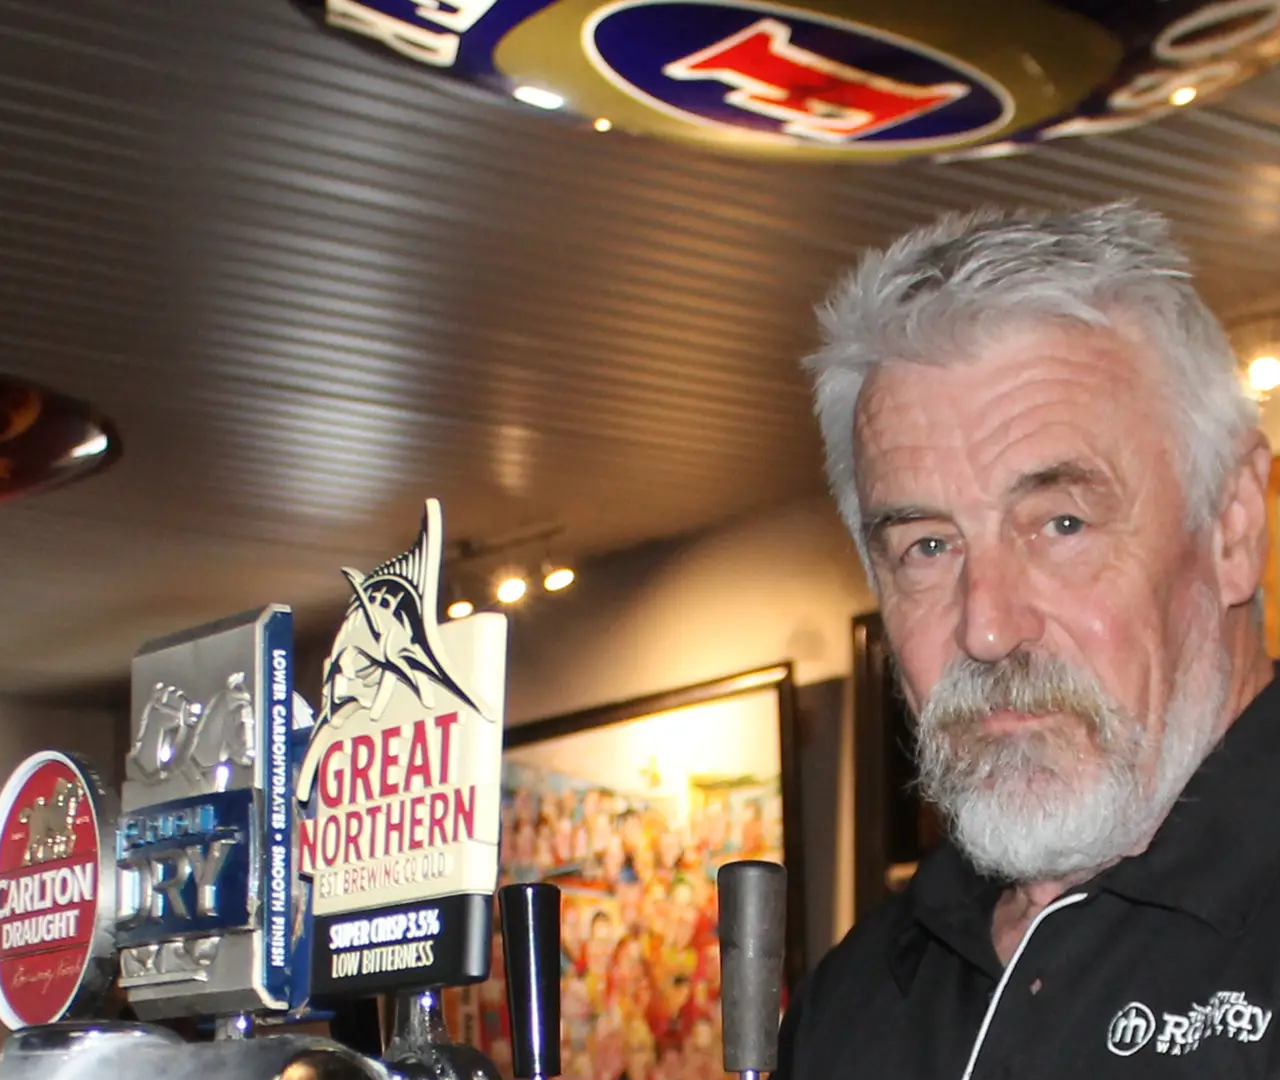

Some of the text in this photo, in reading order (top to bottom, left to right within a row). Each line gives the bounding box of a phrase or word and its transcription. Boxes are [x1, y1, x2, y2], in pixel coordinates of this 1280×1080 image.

[319, 711, 459, 809] GREAT
[271, 648, 288, 967] LOWER CARBOHYDRATES SMOOTH FINISH
[297, 784, 477, 873] NORTHERN
[343, 859, 400, 894] BREWING
[421, 851, 446, 880] QLD
[1, 908, 80, 950] DRAUGHT
[328, 907, 441, 950] SUPER CRISP 3.5%
[331, 939, 435, 979] LOW BITTERNESS
